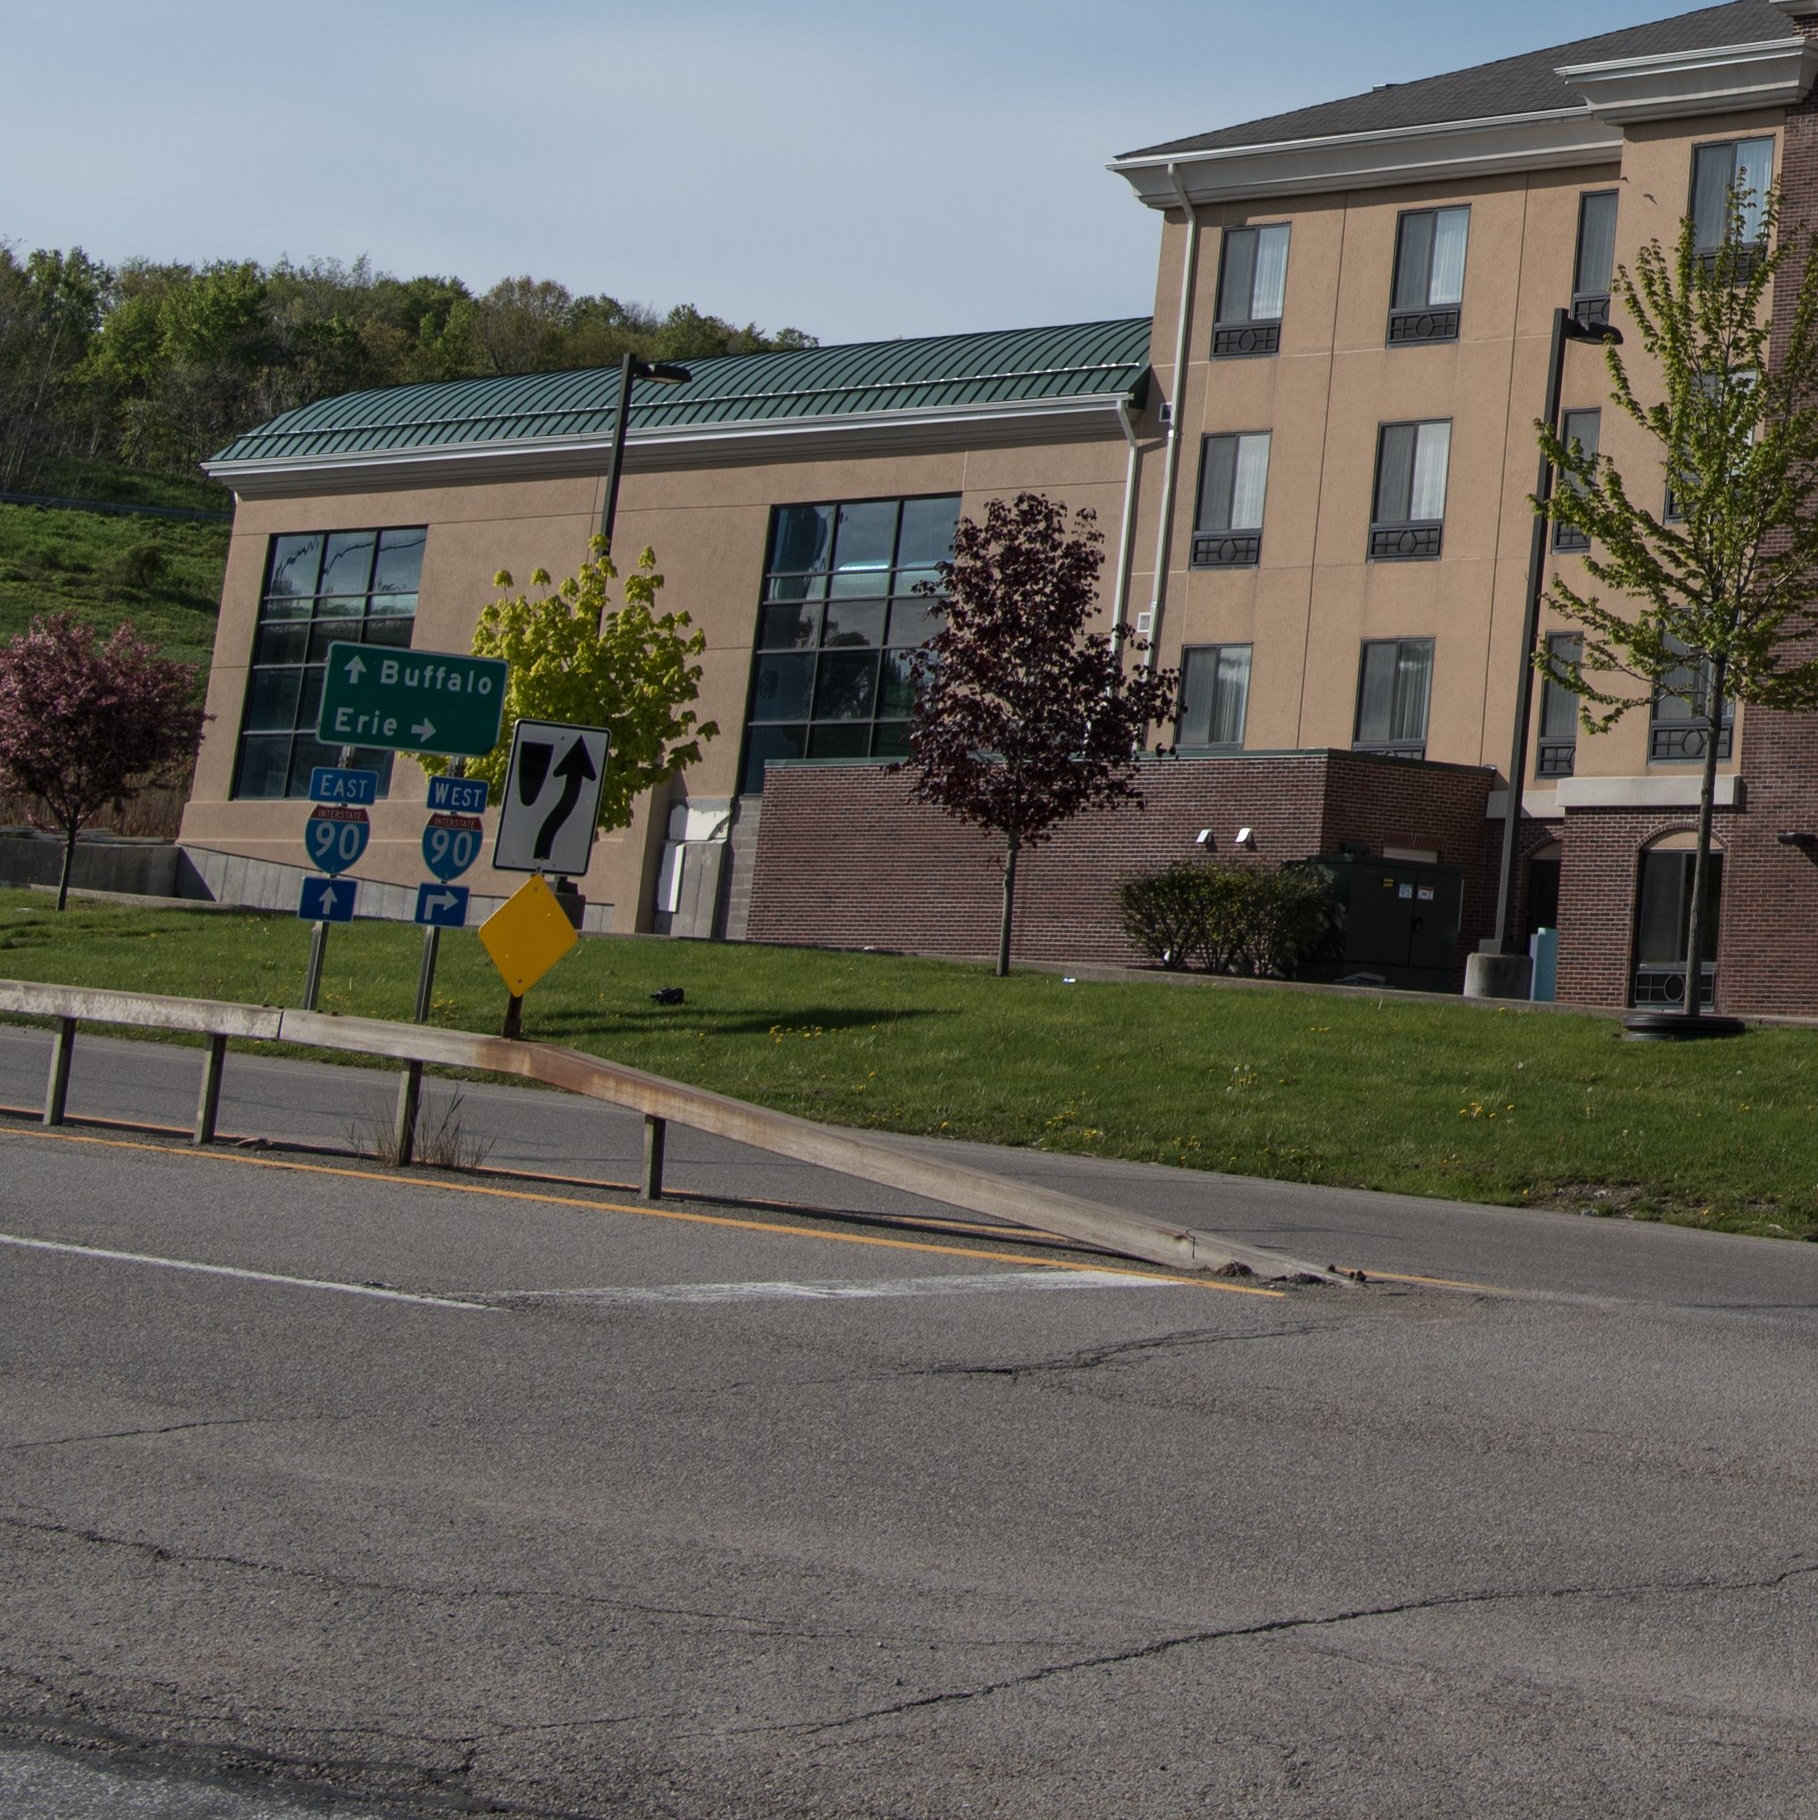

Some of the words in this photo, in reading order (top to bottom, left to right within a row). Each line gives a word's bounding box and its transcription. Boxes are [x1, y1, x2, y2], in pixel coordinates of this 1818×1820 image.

[380, 659, 493, 695] Buffalo
[335, 707, 398, 736] Erie
[320, 774, 368, 798] EAST
[435, 782, 482, 808] WEST
[318, 809, 362, 821] INTERSTATE
[434, 817, 477, 829] INTERSTATE
[315, 821, 360, 861] 90
[431, 829, 473, 868] 90
